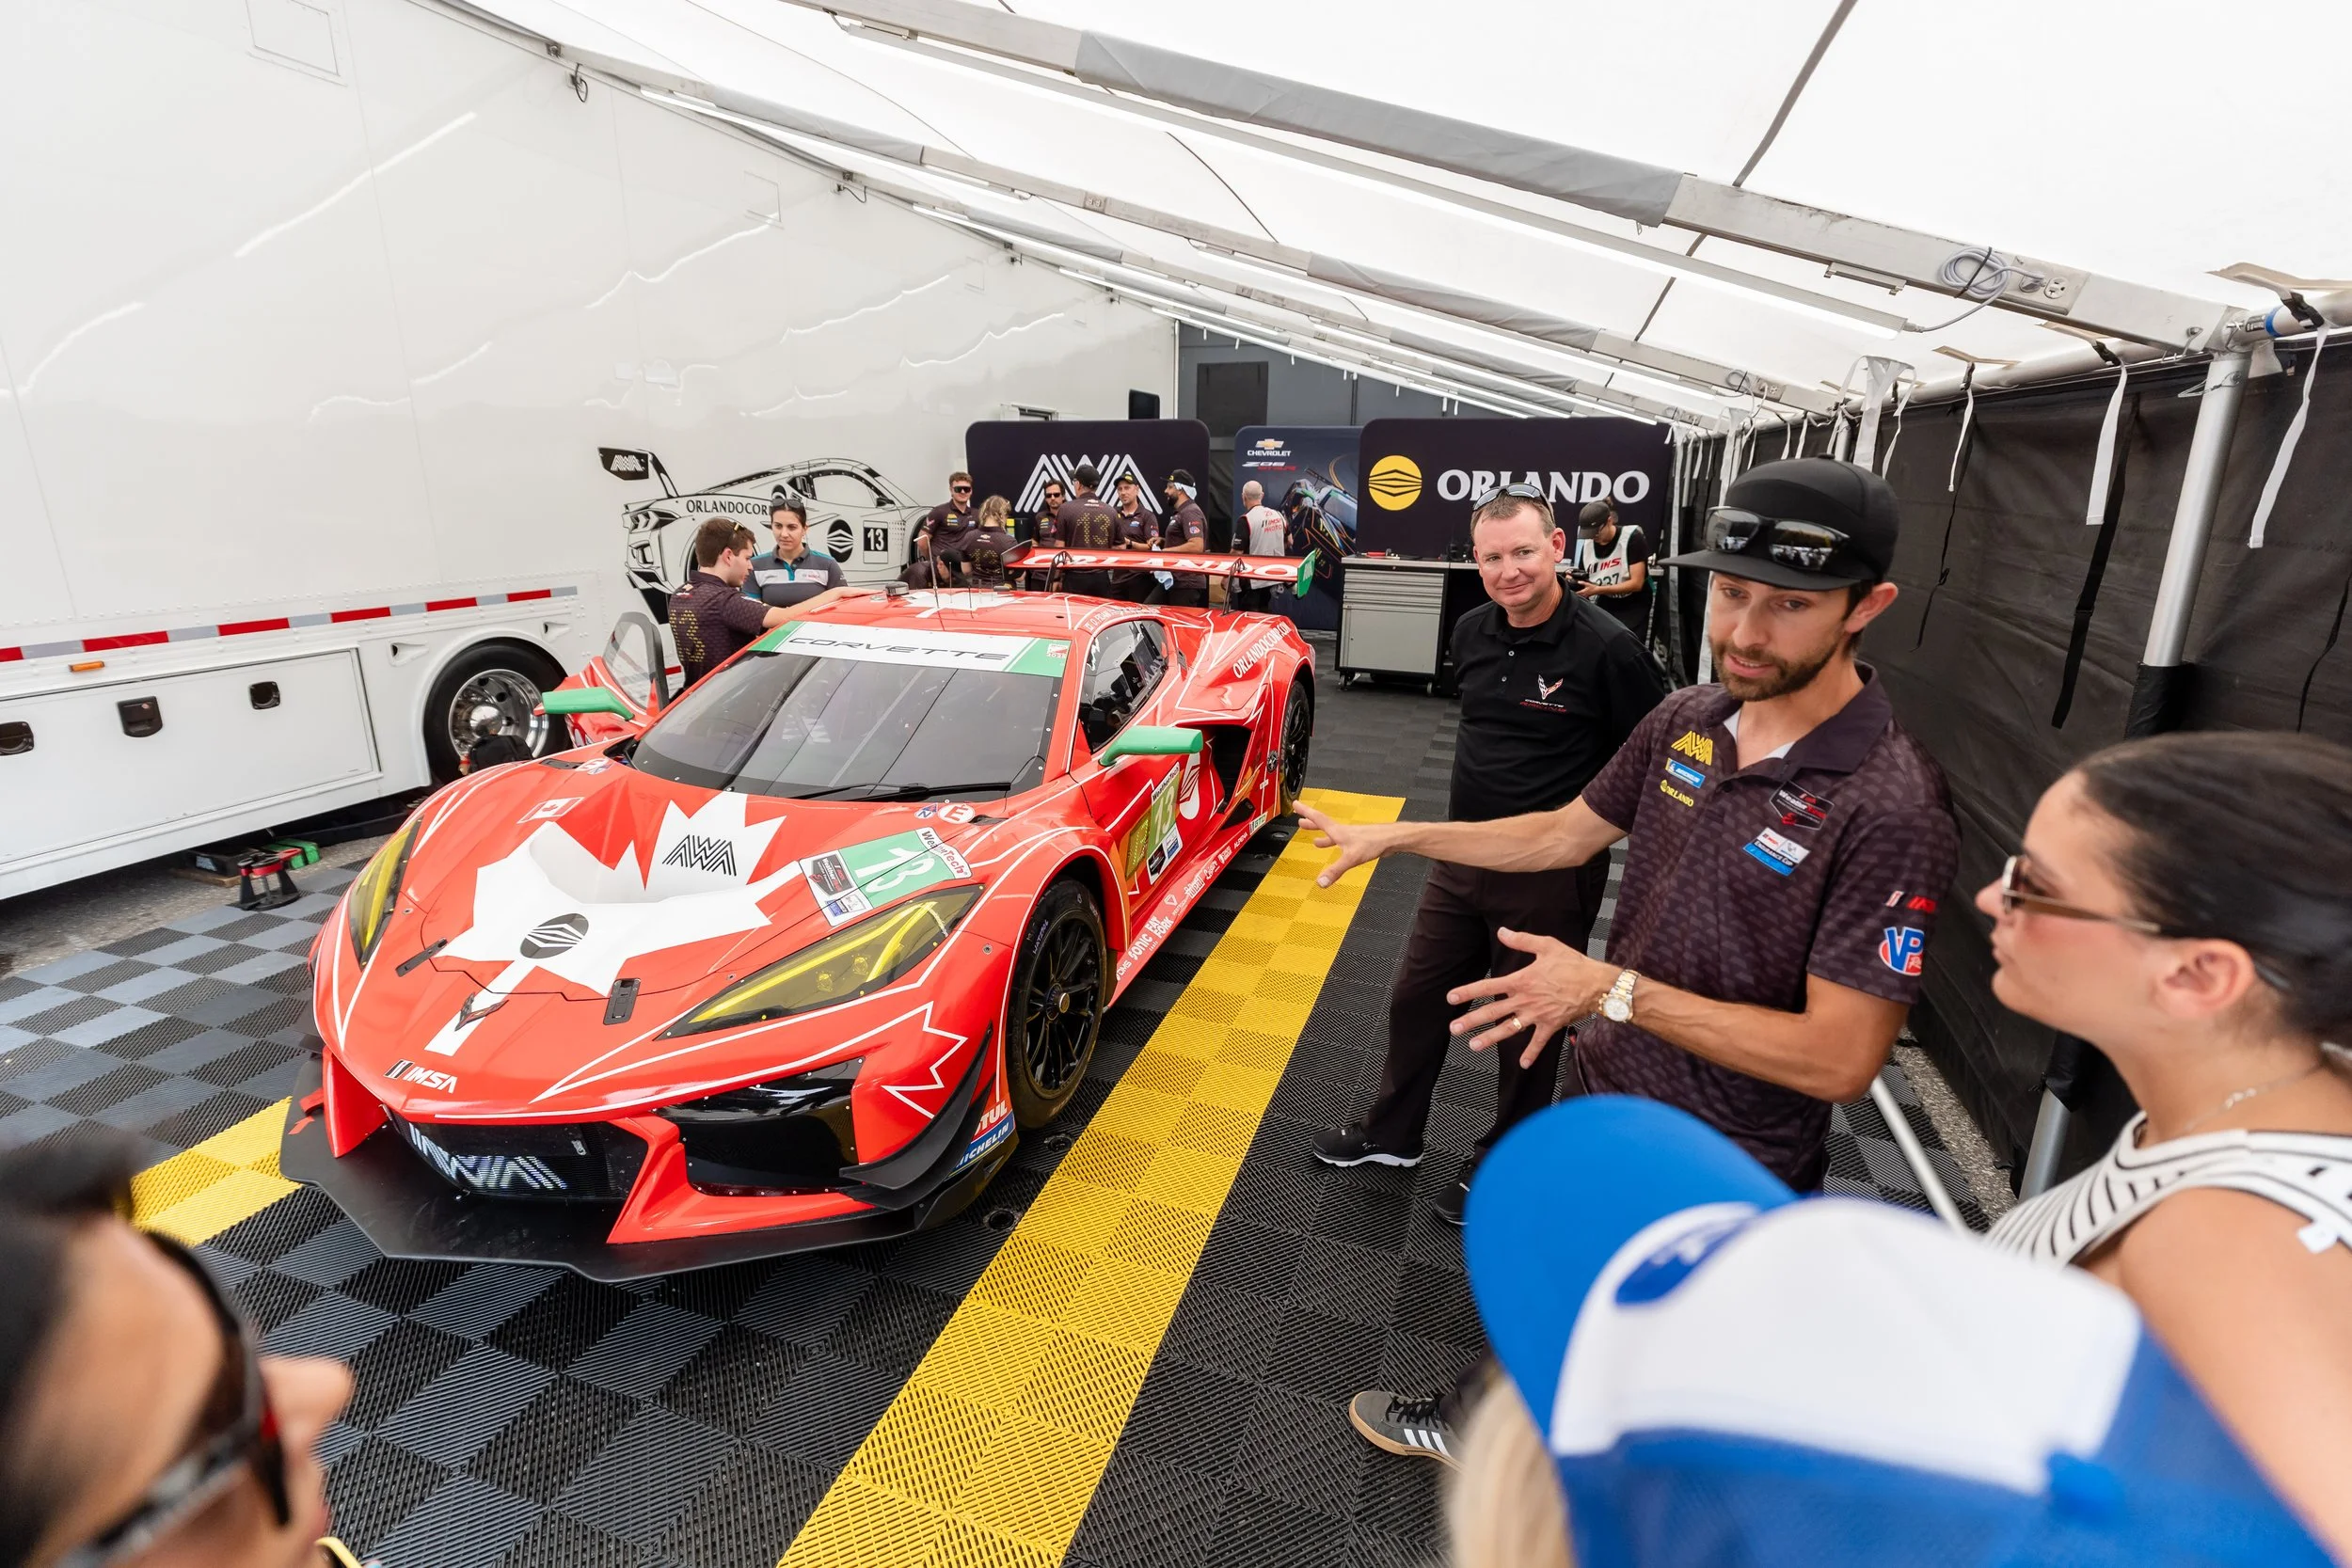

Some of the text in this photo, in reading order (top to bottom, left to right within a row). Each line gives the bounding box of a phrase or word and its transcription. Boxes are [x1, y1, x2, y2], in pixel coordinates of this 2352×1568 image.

[686, 499, 771, 516] ORLANDOCOR
[866, 527, 885, 551] 13
[1076, 513, 1111, 545] 13
[1023, 554, 1298, 578] ORLANDO
[1599, 558, 1622, 571] IMS
[788, 637, 1009, 661] CORVETTE
[1671, 731, 1713, 767] AWA
[1154, 785, 1175, 845] 13
[661, 834, 738, 877] AWA
[854, 847, 935, 894] 13
[1153, 916, 1174, 938] FORK
[1128, 933, 1153, 960] SONIC
[1883, 926, 1925, 974] VP
[403, 1066, 458, 1094] IMSA
[975, 1100, 1008, 1136] TUL
